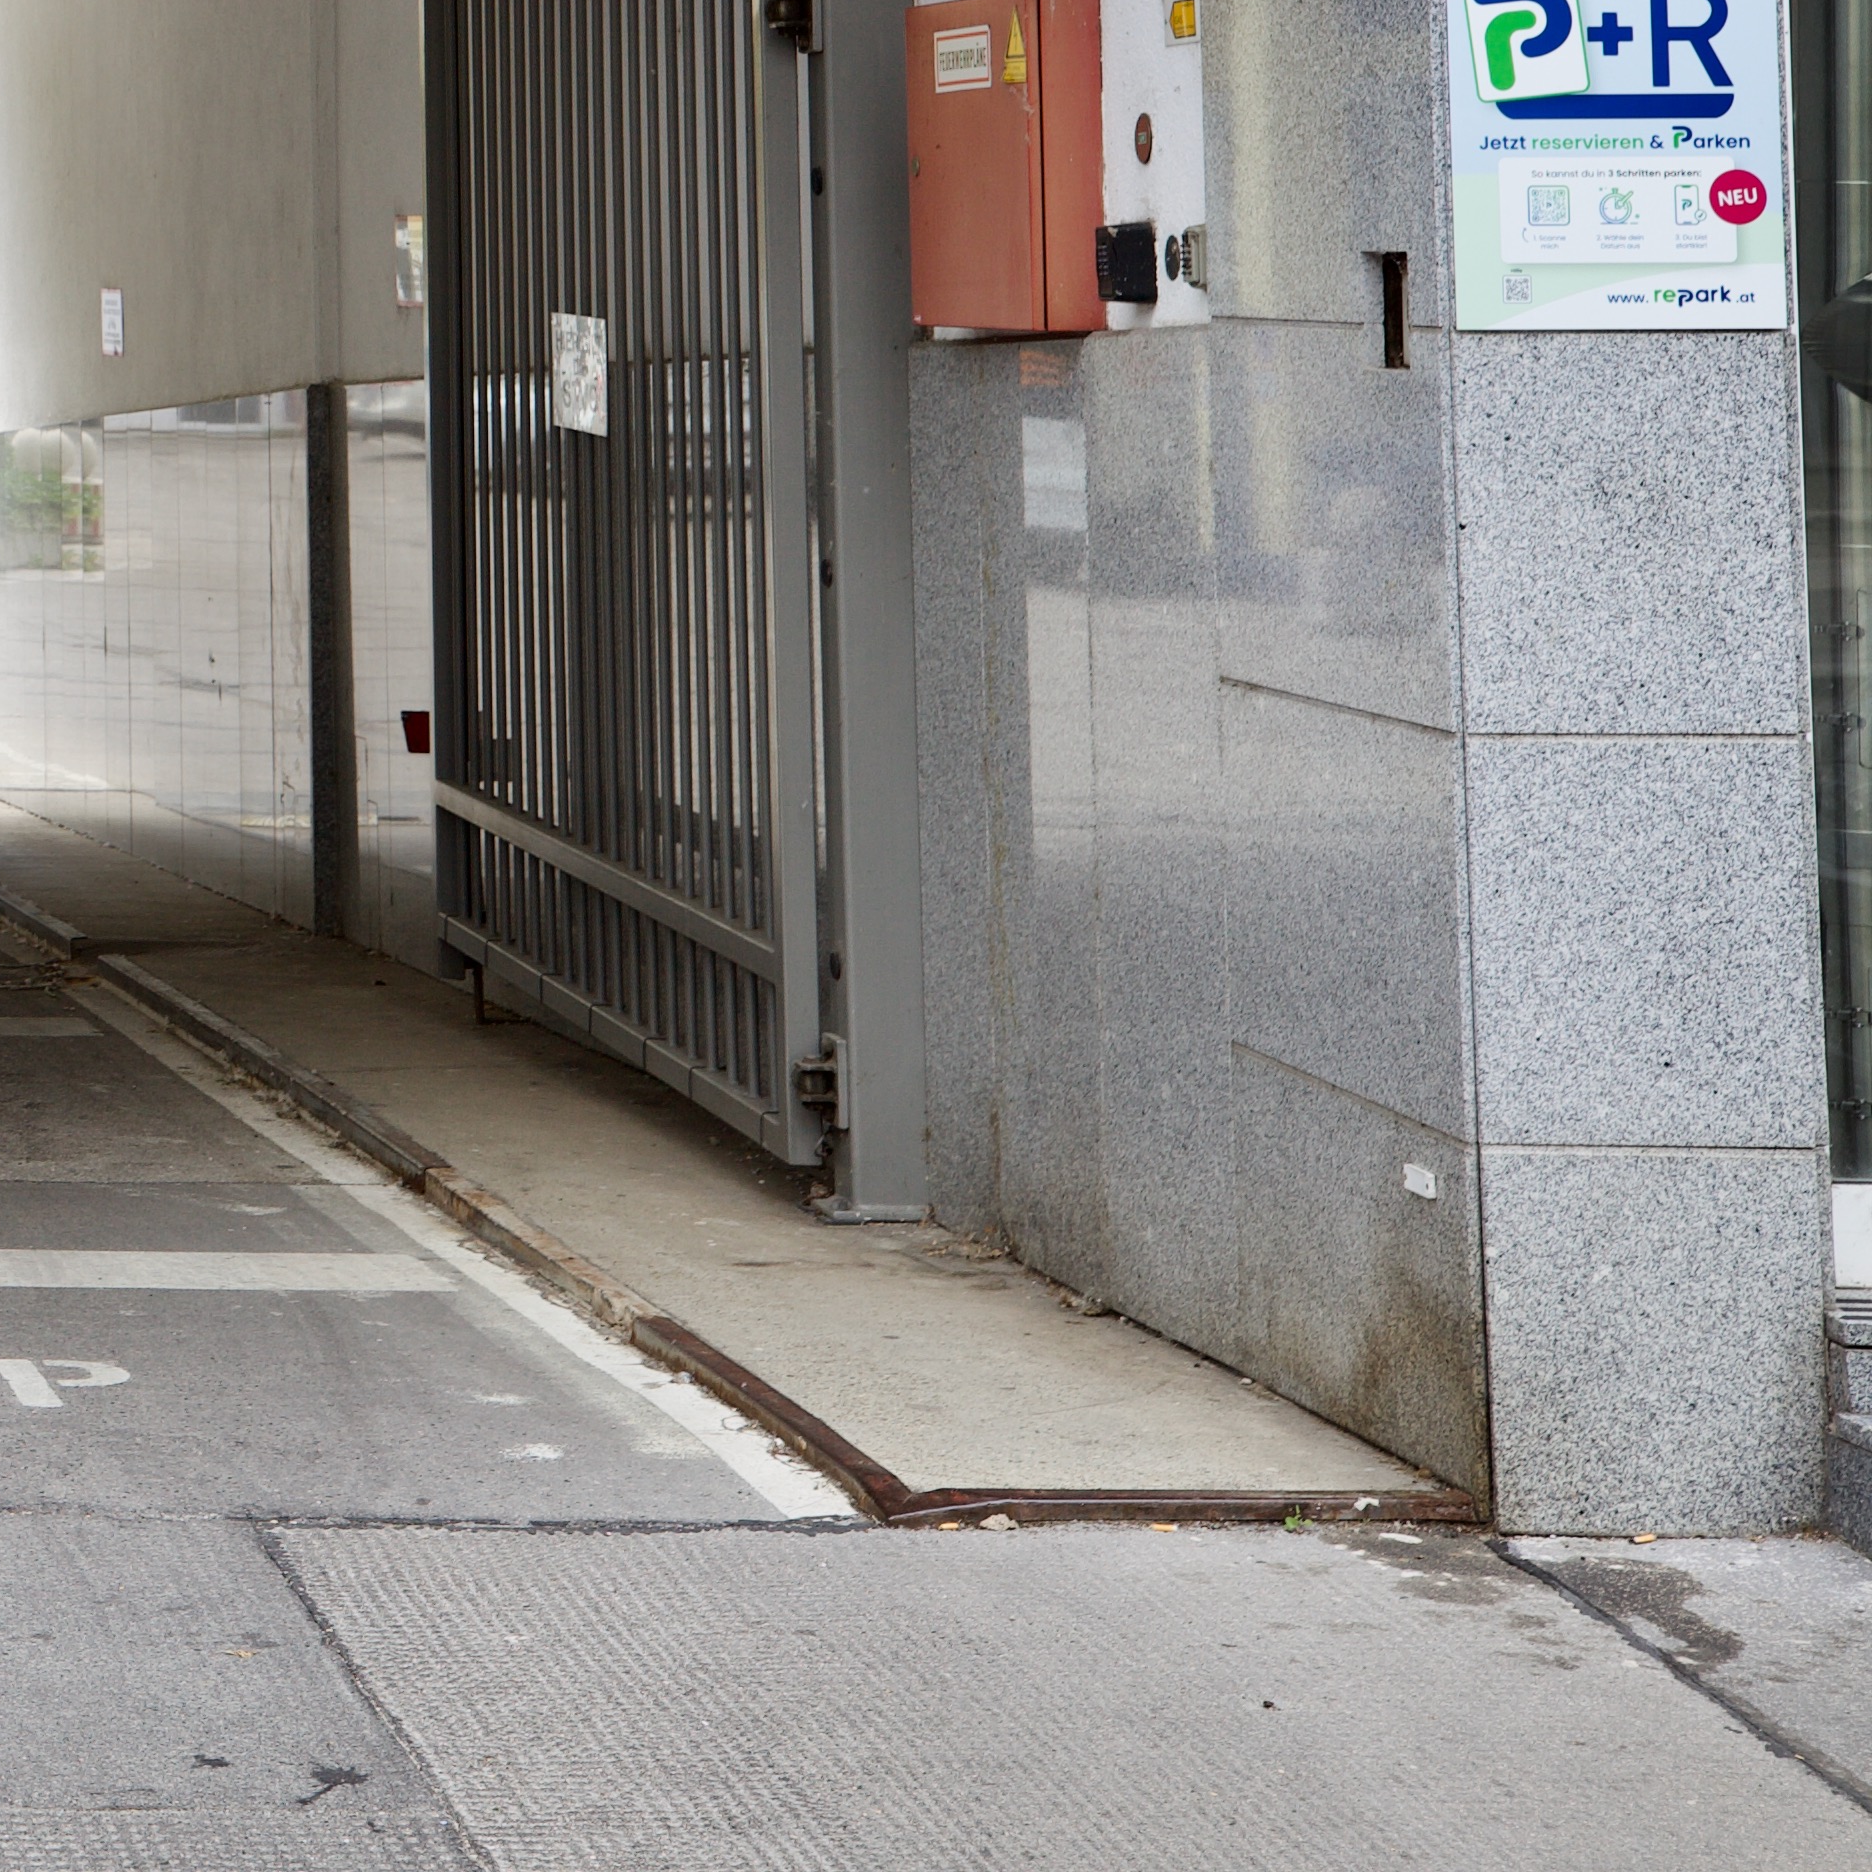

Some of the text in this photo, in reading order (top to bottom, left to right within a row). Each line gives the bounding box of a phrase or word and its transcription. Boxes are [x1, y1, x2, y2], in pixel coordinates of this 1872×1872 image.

[939, 41, 987, 72] FEUERWEHRPLÄNE
[1479, 126, 1751, 150] Jetzt reservieren & Parken
[1531, 169, 1702, 179] So kannst du in 3 Schritten parken:
[1717, 187, 1758, 207] NEU
